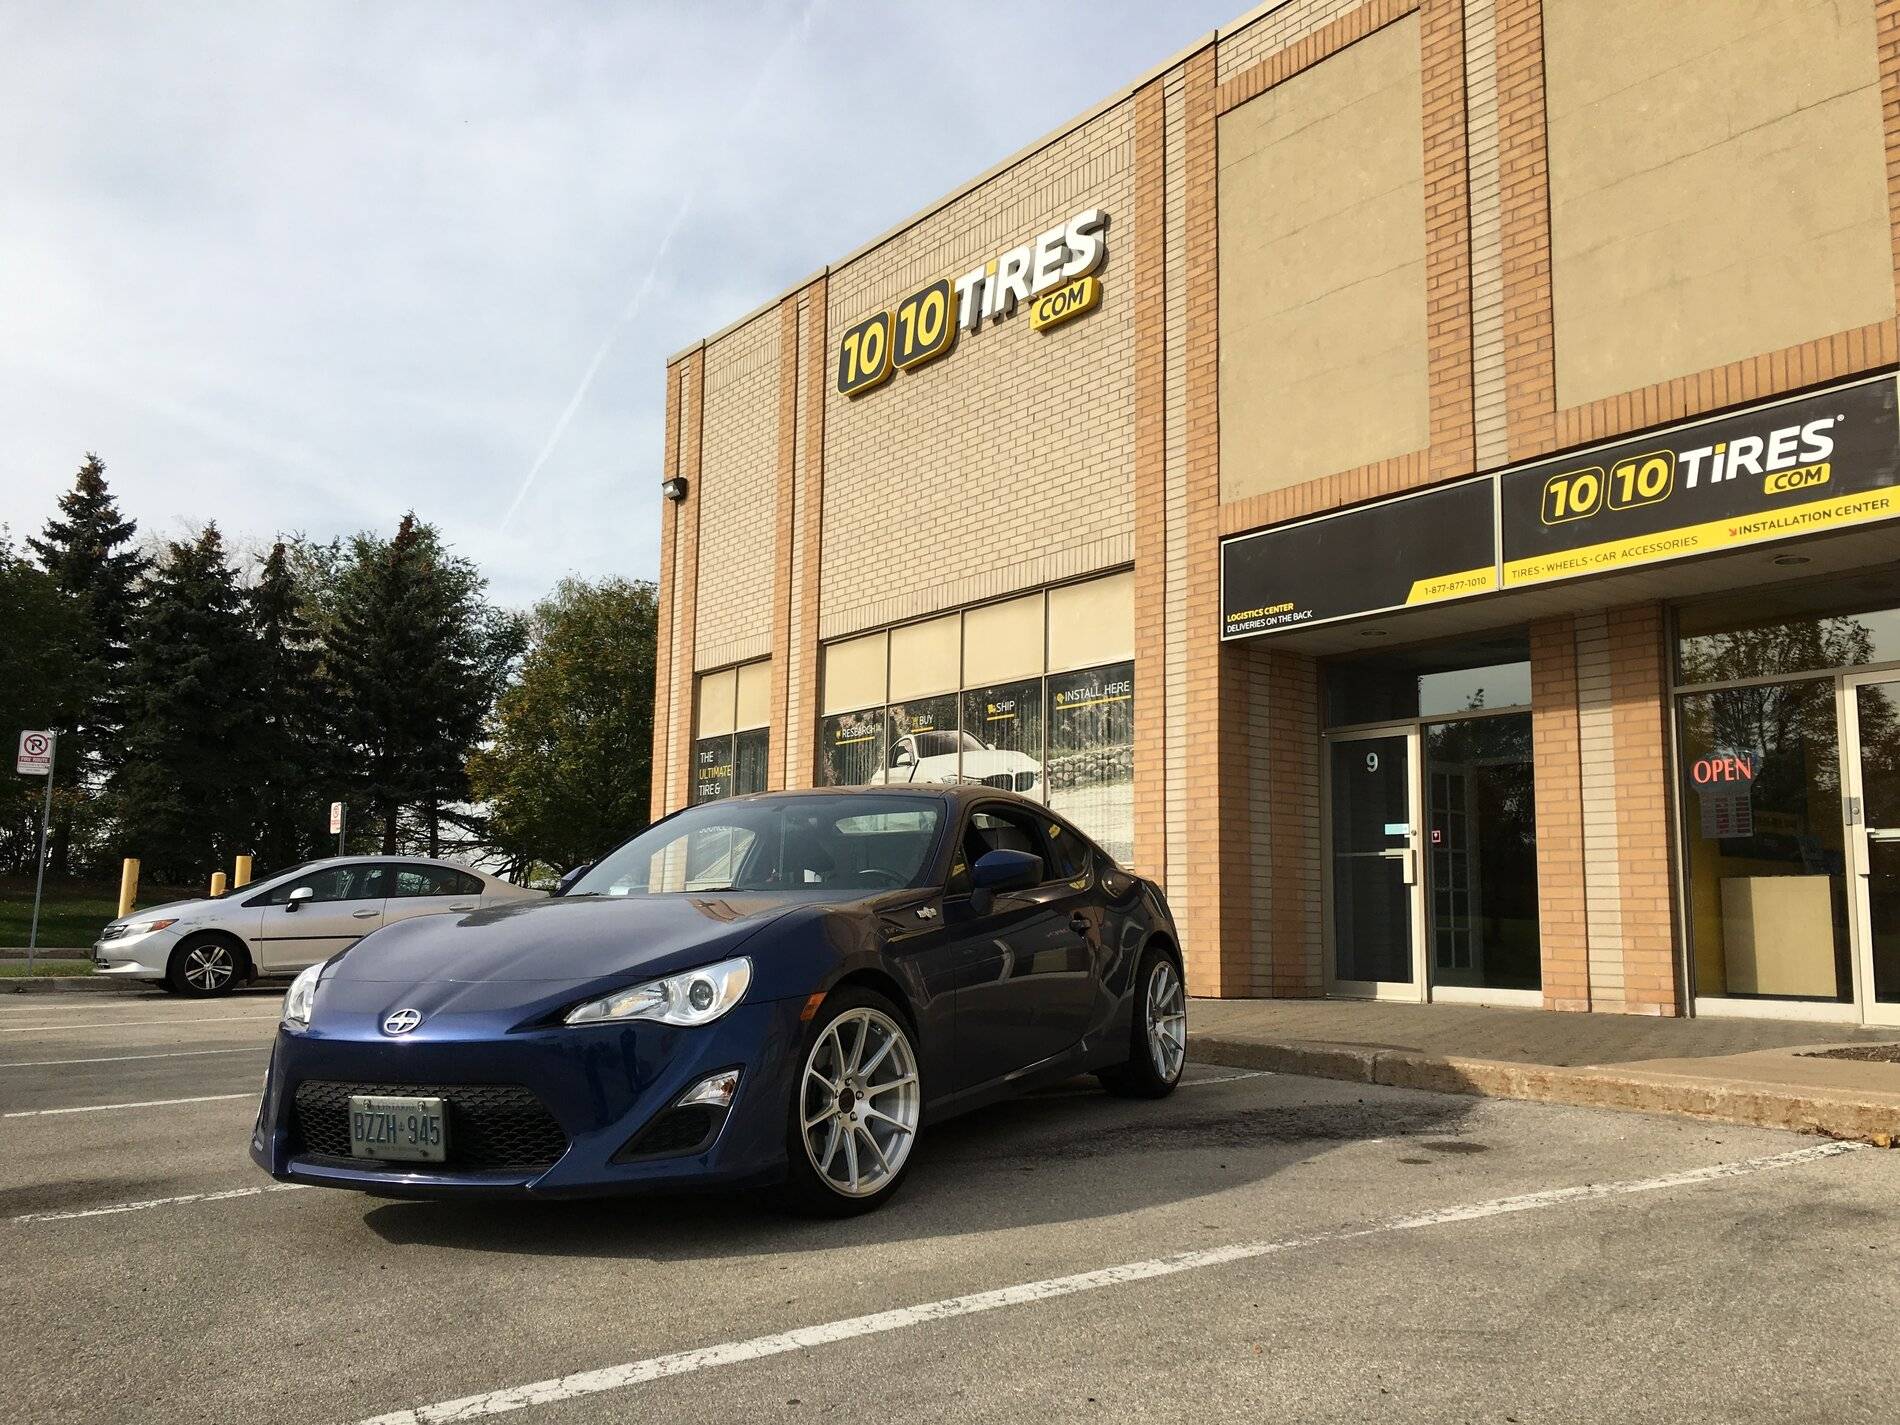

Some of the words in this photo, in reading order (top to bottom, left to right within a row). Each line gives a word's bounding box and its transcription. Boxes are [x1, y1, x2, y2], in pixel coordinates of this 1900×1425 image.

[844, 322, 885, 383] 10
[900, 290, 945, 355] 10
[1550, 475, 1599, 517] 10
[1617, 458, 1669, 502] 10
[1739, 509, 1832, 535] INSTALLATION
[1835, 499, 1890, 517] CENTER
[1511, 566, 1540, 579] TIRES
[1547, 557, 1588, 572] WHEELS
[1594, 552, 1617, 563] CAR
[1621, 536, 1699, 557] ACCESSORIES
[1425, 577, 1487, 595] 1-877-877-1010
[1227, 609, 1264, 622] LOGISTICS
[1264, 603, 1294, 615] CENTER
[1227, 619, 1266, 633] DELIVERIES
[1266, 617, 1277, 626] ON
[1278, 614, 1292, 623] THE
[1293, 610, 1313, 620] BACK
[1065, 686, 1101, 701] INSTALL
[1104, 680, 1130, 695] HERE
[996, 700, 1015, 712] SHIP
[920, 714, 934, 725] BUY
[842, 725, 876, 738] RESEARCH
[700, 751, 714, 763] THE
[1366, 752, 1379, 772] 9
[699, 764, 732, 780] ULTIMATE
[1693, 757, 1752, 783] OPEN
[354, 1111, 396, 1144] BZZH
[407, 1114, 440, 1145] 945
